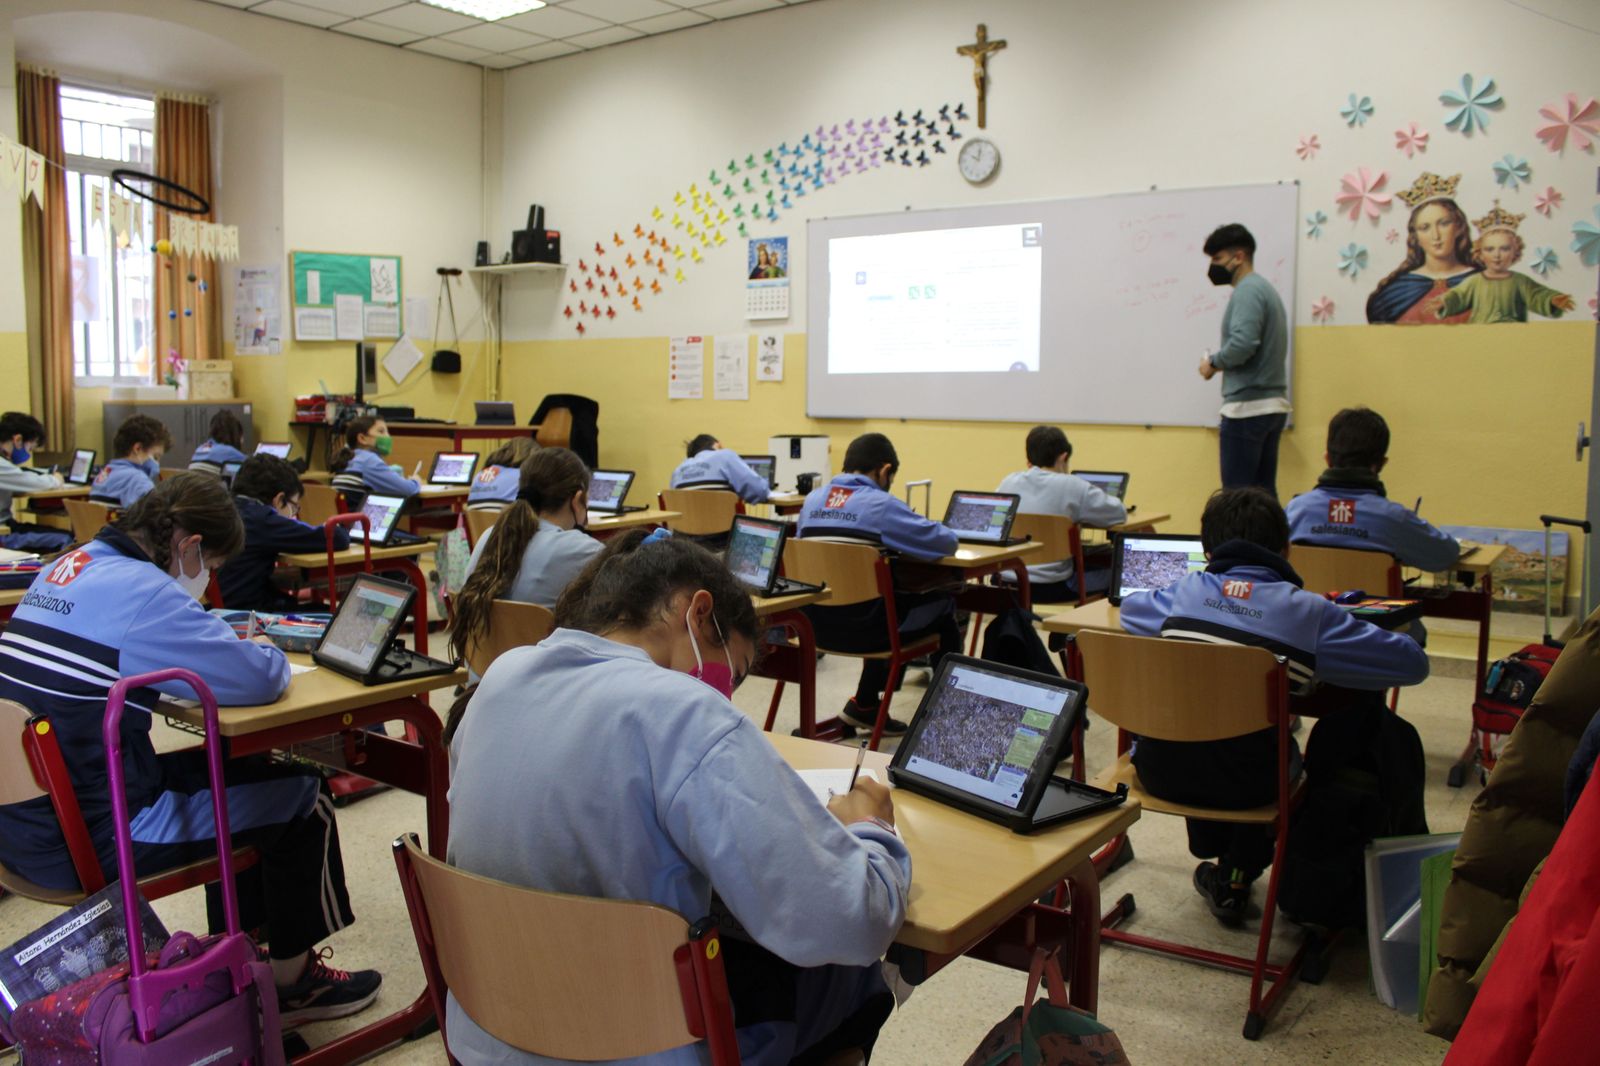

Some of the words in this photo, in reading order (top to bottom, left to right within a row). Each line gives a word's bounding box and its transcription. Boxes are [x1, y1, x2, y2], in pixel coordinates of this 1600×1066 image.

[809, 508, 858, 522] salesianos
[1311, 523, 1369, 539] salesianos
[1203, 598, 1264, 620] salesianos
[43, 920, 82, 946] Hernández
[83, 901, 111, 920] Iglesias
